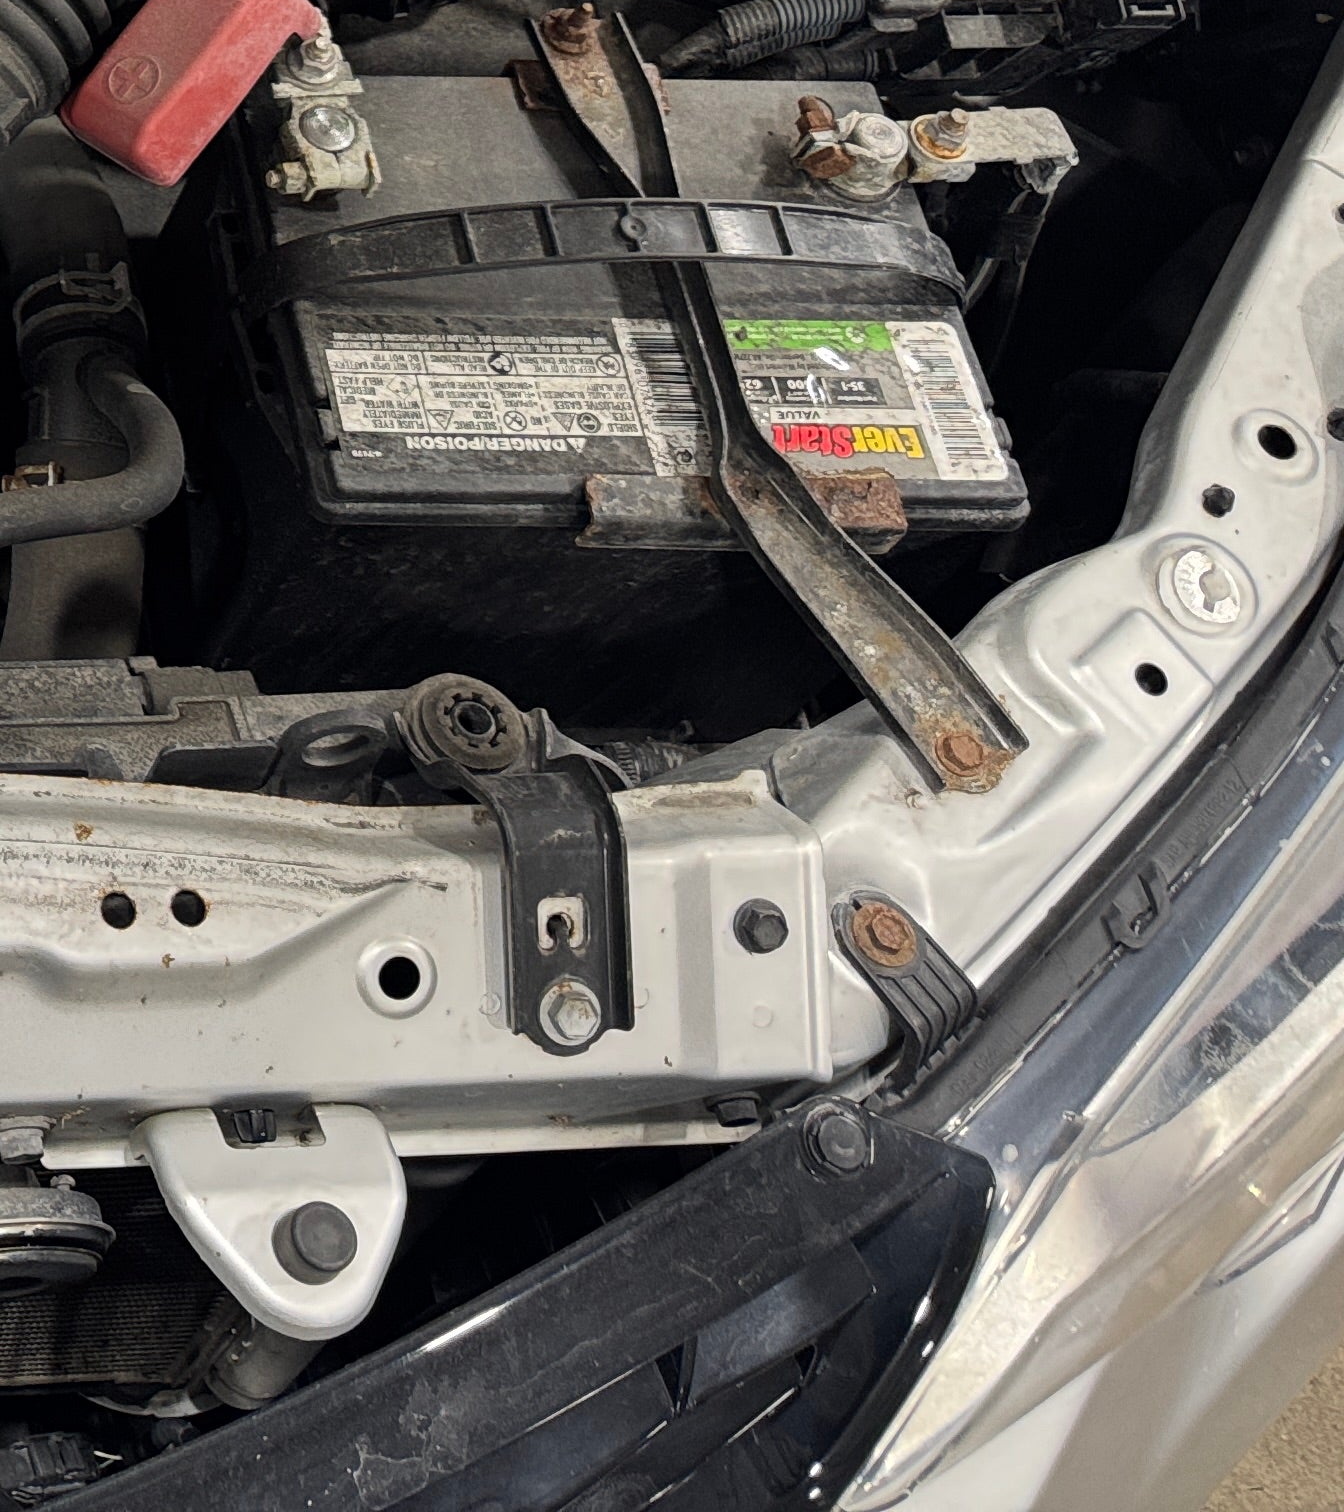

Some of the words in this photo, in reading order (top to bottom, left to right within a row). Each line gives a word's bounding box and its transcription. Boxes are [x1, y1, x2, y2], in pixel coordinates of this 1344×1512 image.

[775, 410, 820, 419] VALUE
[405, 435, 568, 452] DANGER/POISON
[771, 424, 925, 459] EverStart
